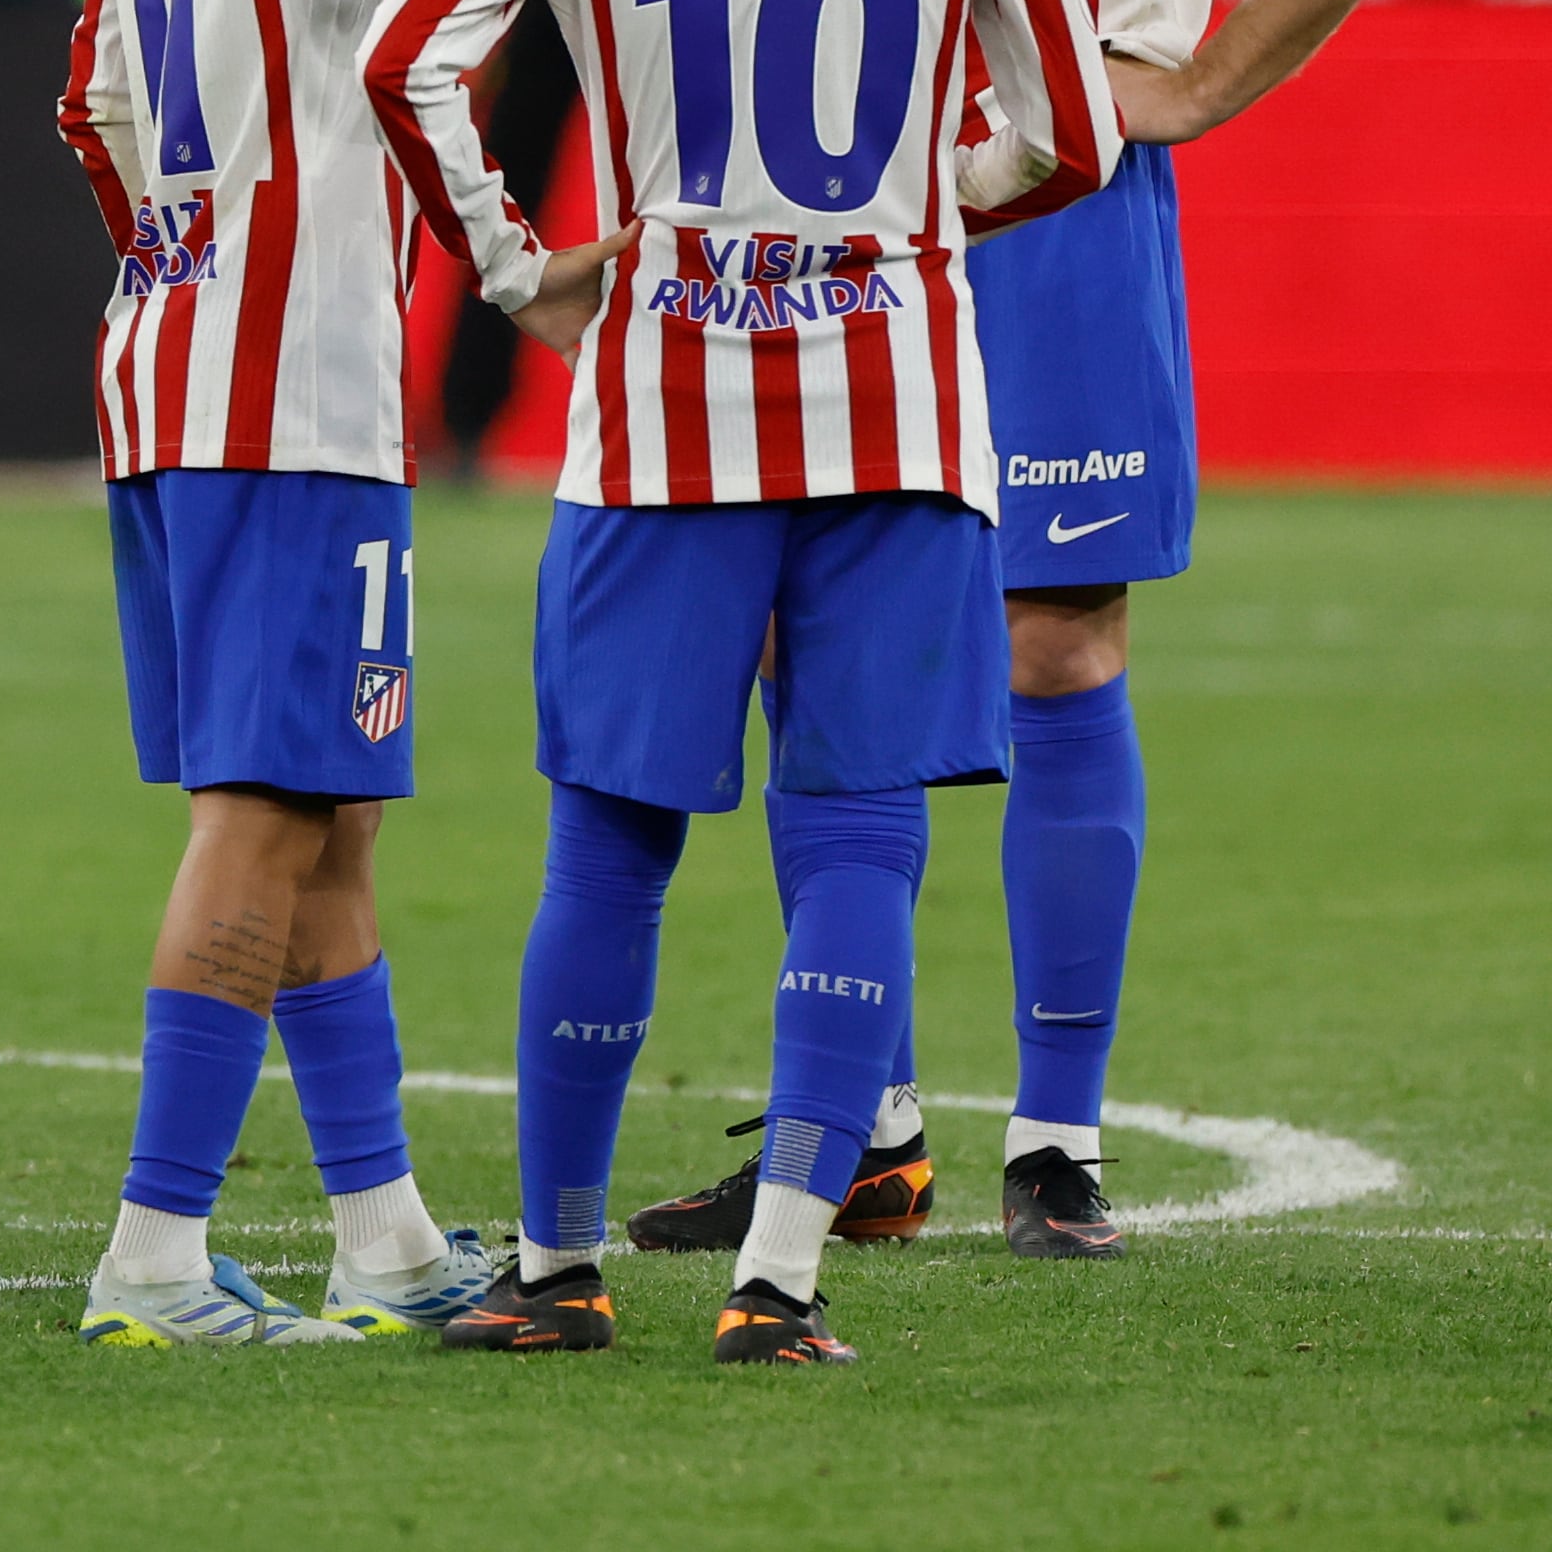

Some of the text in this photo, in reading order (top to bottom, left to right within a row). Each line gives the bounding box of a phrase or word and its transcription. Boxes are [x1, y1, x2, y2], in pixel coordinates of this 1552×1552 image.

[133, 200, 204, 249] SIT
[699, 236, 852, 282] VISIT
[648, 272, 905, 332] RWANDA
[1007, 450, 1145, 486] ComAve
[780, 970, 885, 1006] ATLETI
[552, 1014, 653, 1043] ATLET
